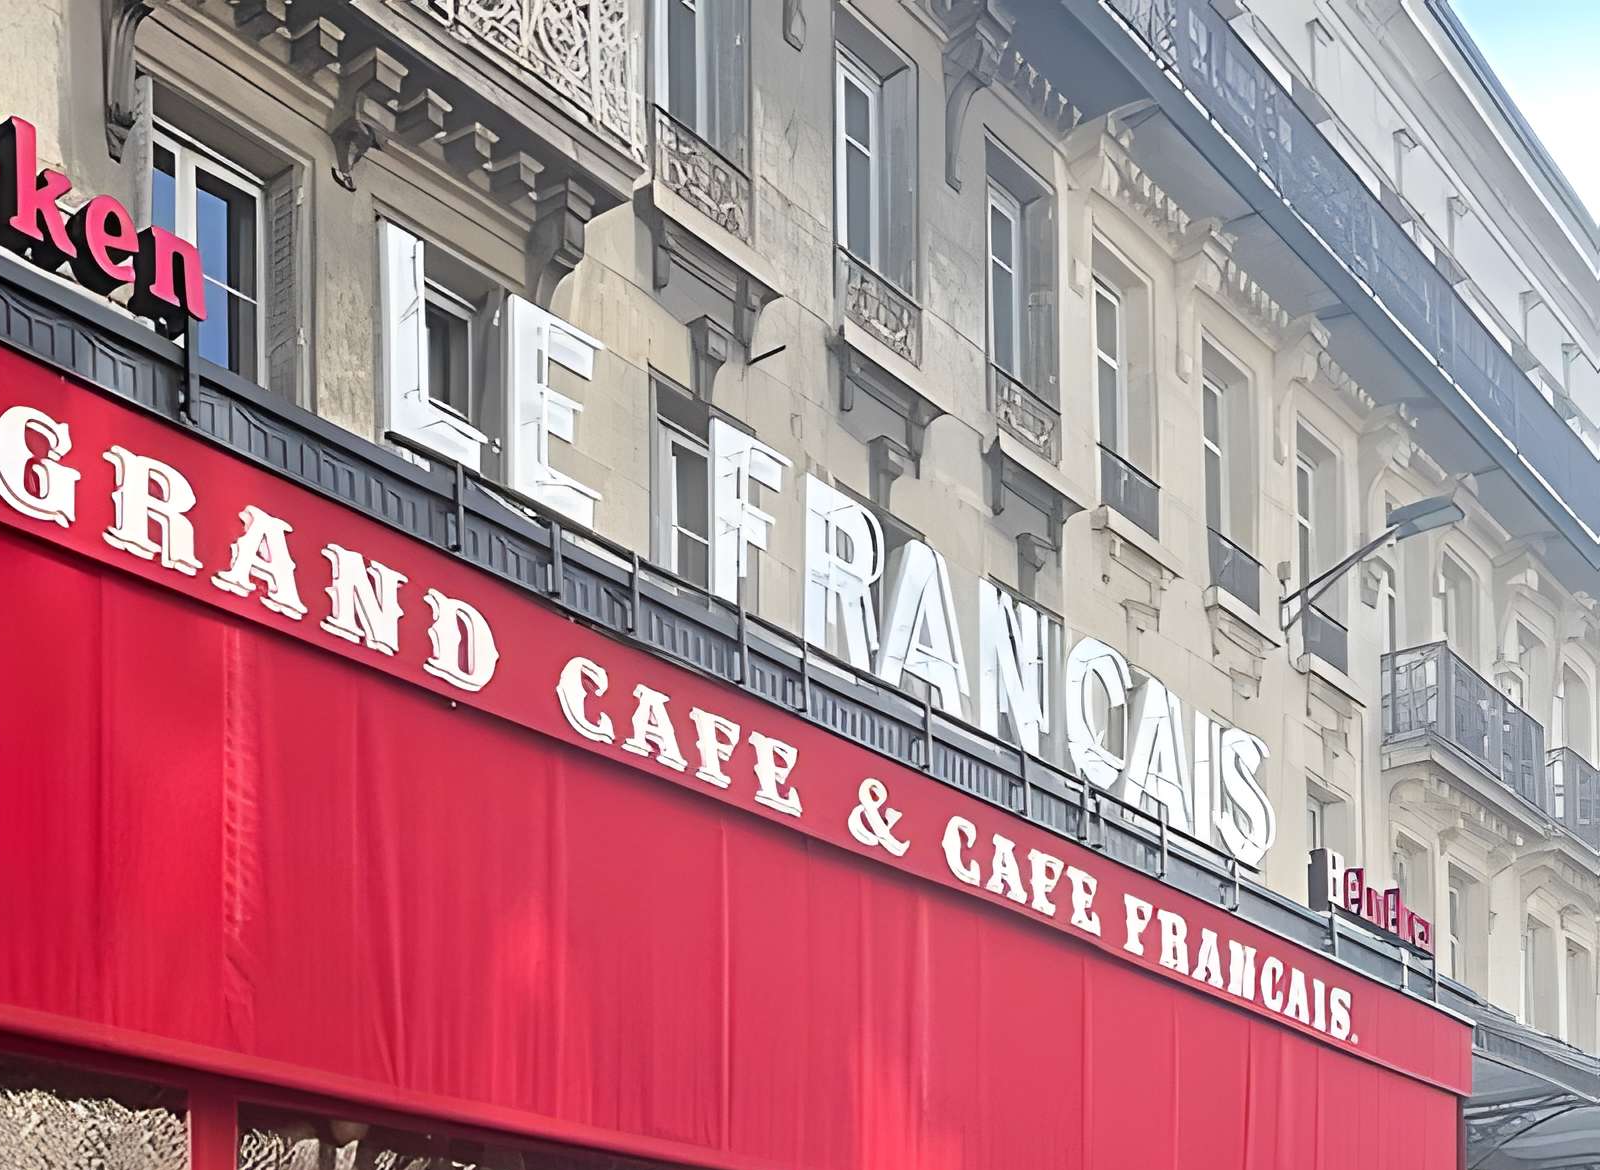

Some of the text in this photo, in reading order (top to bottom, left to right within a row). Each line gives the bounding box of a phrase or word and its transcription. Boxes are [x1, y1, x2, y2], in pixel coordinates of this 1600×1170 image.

[378, 217, 605, 532] LE
[555, 656, 803, 817] CAFE
[847, 777, 911, 857] &
[941, 815, 1102, 937] CAFE
